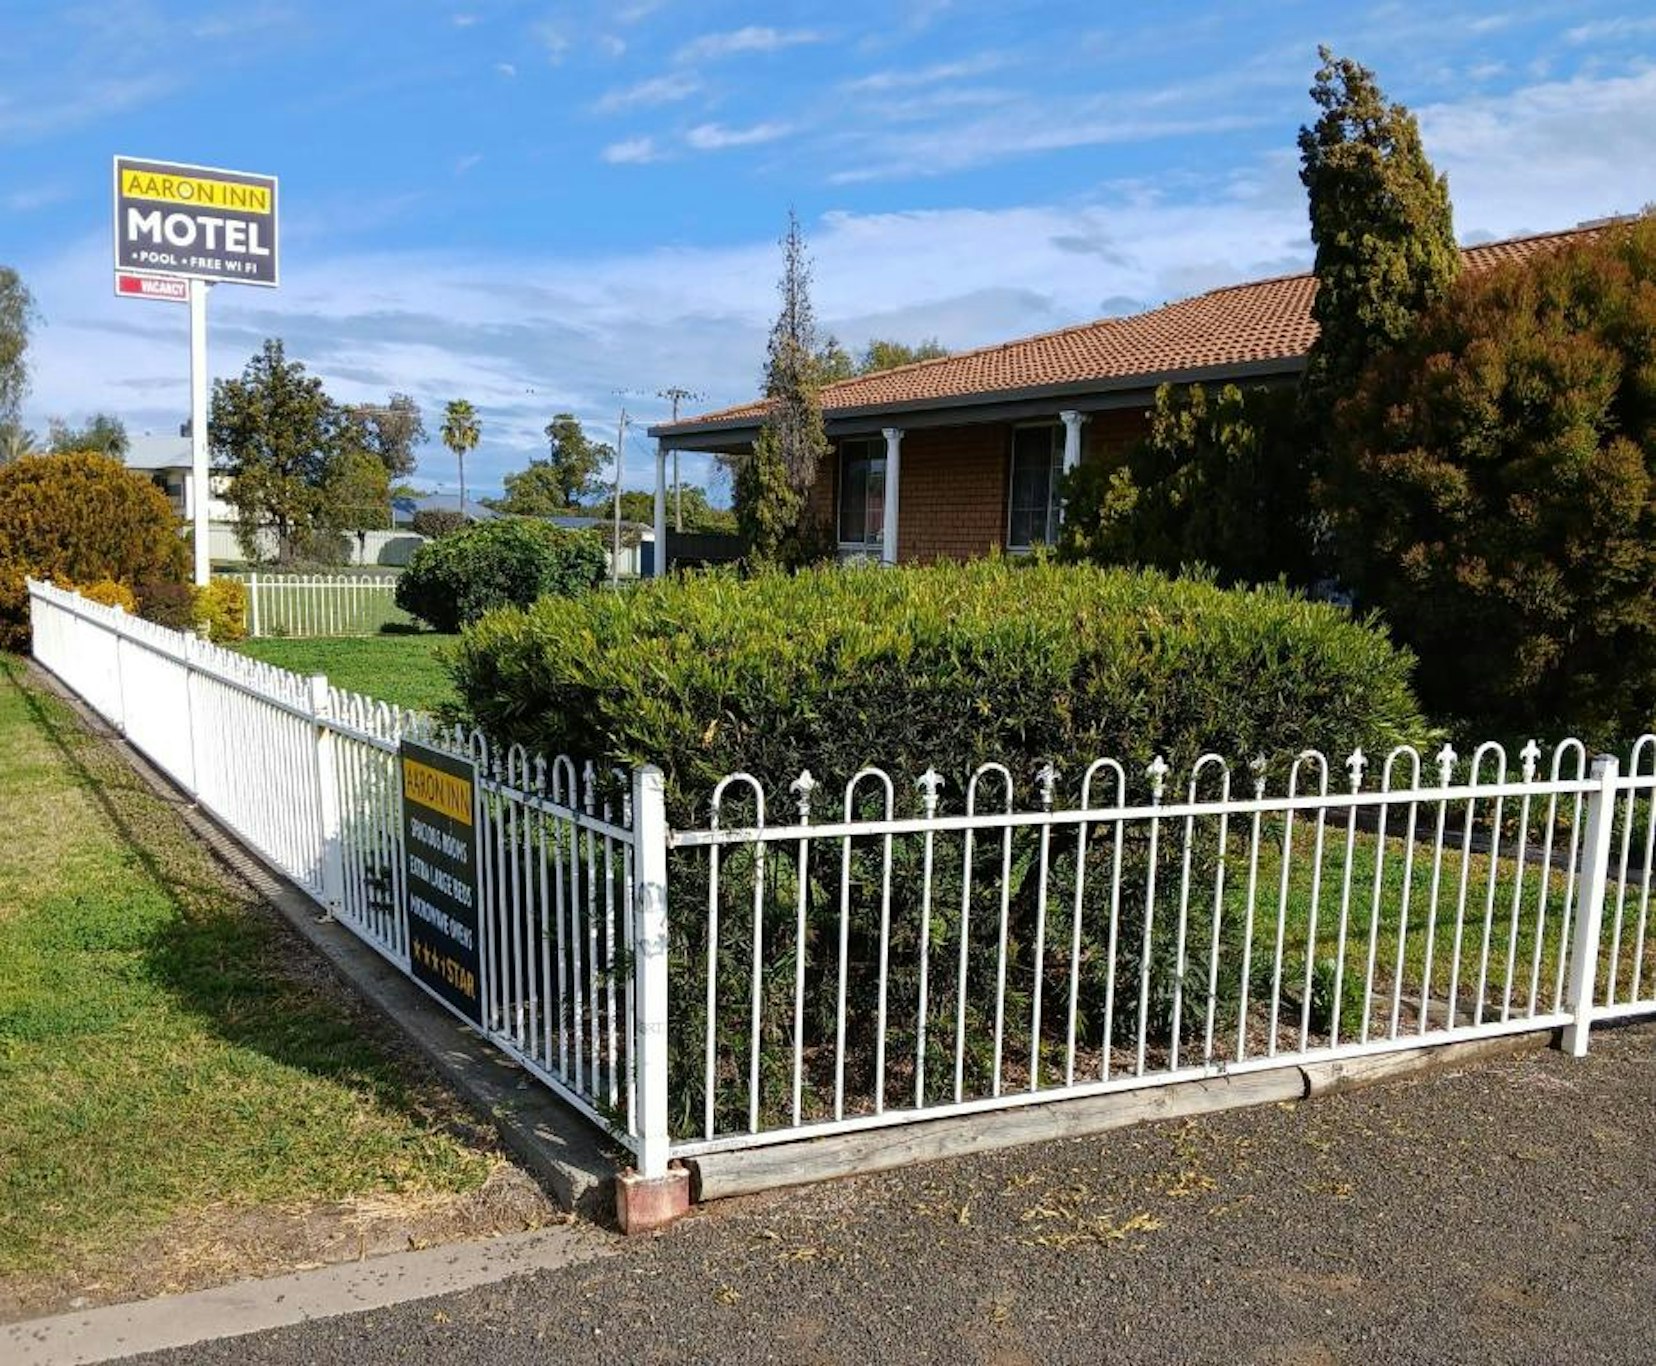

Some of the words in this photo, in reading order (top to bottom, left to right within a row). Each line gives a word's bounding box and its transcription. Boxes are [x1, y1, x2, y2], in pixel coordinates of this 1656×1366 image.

[128, 174, 214, 203] AARON
[223, 184, 266, 210] INN
[127, 207, 270, 256] MOTEL
[140, 251, 177, 266] POOL
[190, 256, 222, 270] FREE
[142, 279, 185, 298] VACANCY
[405, 767, 443, 806] AARON
[448, 778, 471, 817] INN
